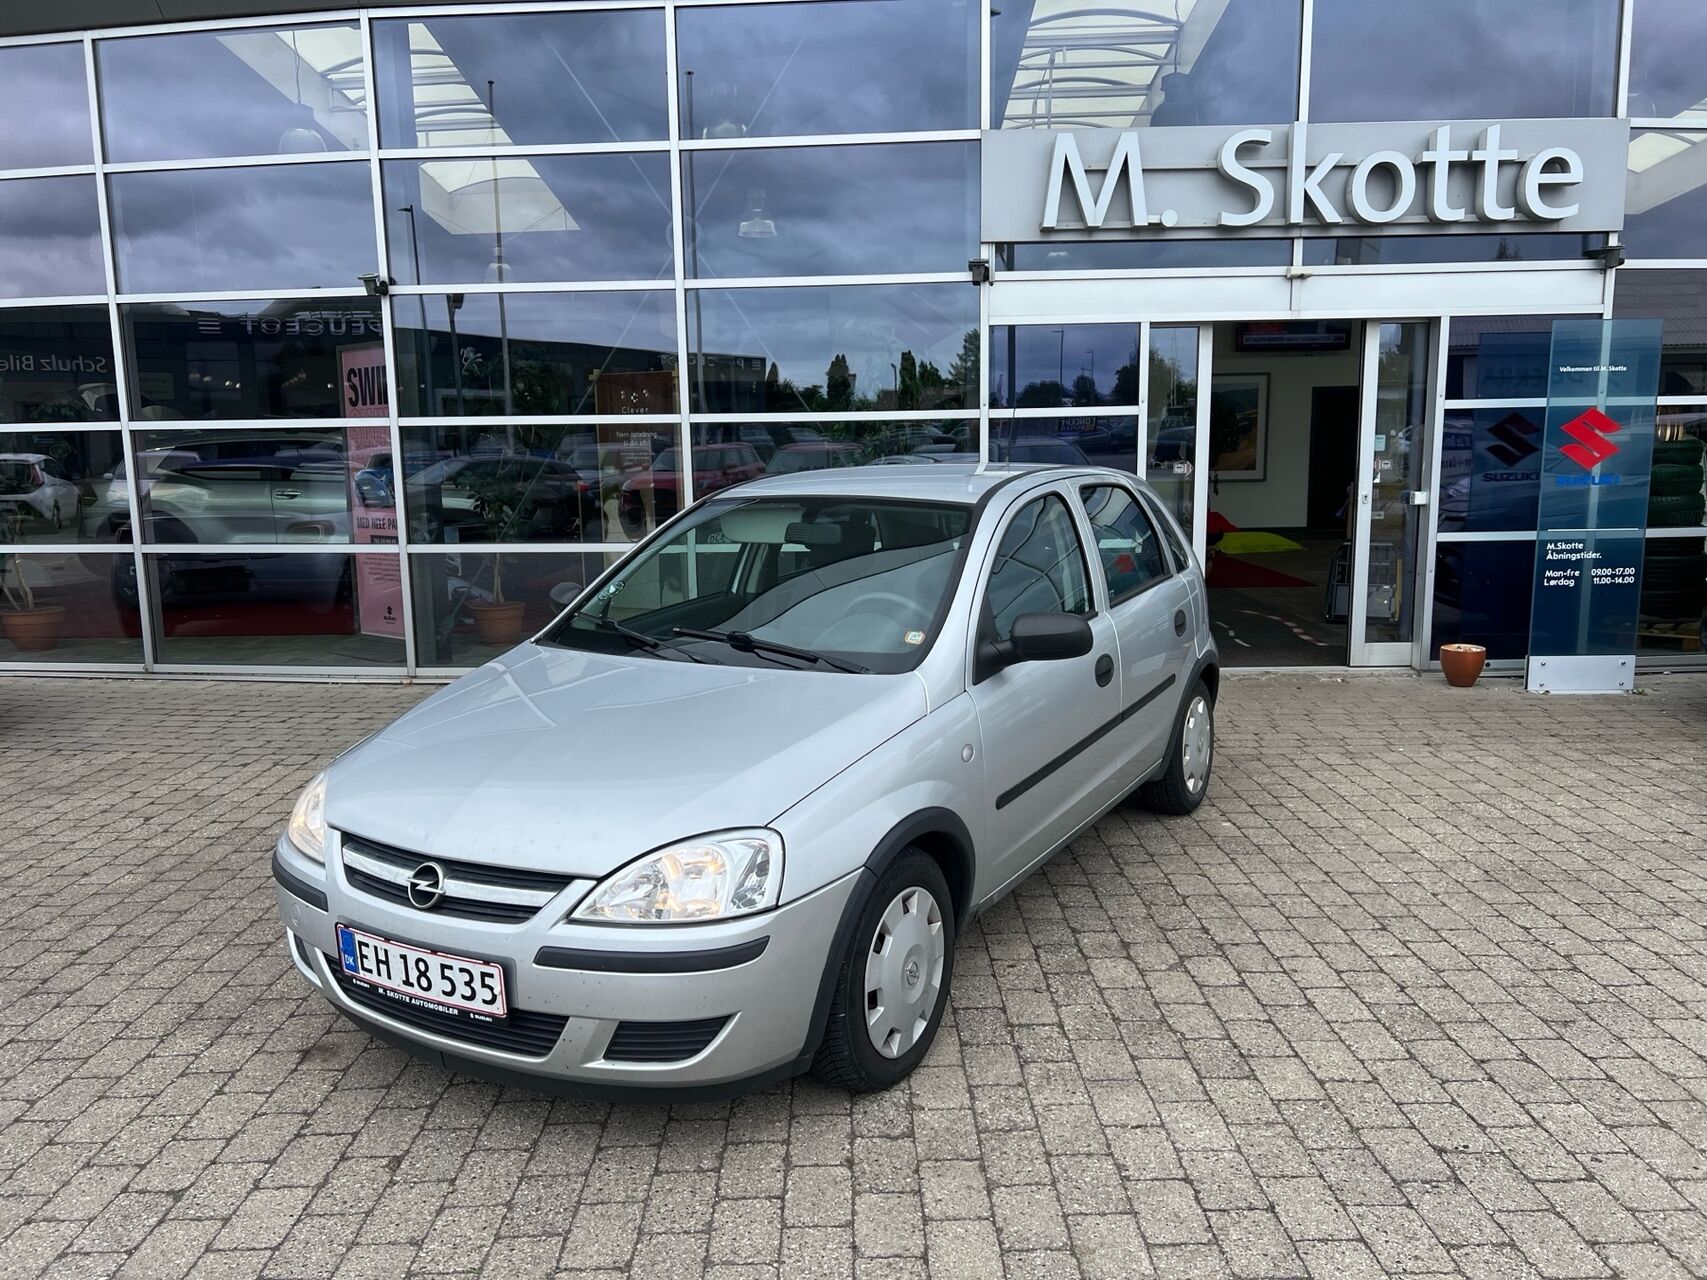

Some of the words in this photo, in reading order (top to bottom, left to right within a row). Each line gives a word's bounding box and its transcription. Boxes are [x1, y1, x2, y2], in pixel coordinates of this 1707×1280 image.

[1038, 130, 1179, 233] M.
[1216, 121, 1584, 229] Skotte
[1559, 365, 1593, 373] Velkommen
[621, 406, 649, 414] Clever
[1483, 472, 1541, 483] SUZUKI
[387, 517, 398, 531] PA
[1545, 550, 1602, 561] Åbningstider.
[1544, 568, 1581, 578] Man-fre
[1591, 567, 1636, 576] 09.00-17.00
[1543, 578, 1575, 587] Lørdag
[1592, 576, 1635, 585] 11.00-14.00
[344, 954, 355, 967] DK
[357, 939, 392, 981] EH
[399, 953, 433, 992] 18
[440, 962, 498, 1006] 535
[386, 990, 410, 1003] SKOTTE
[411, 998, 459, 1016] AUTOMOBILER
